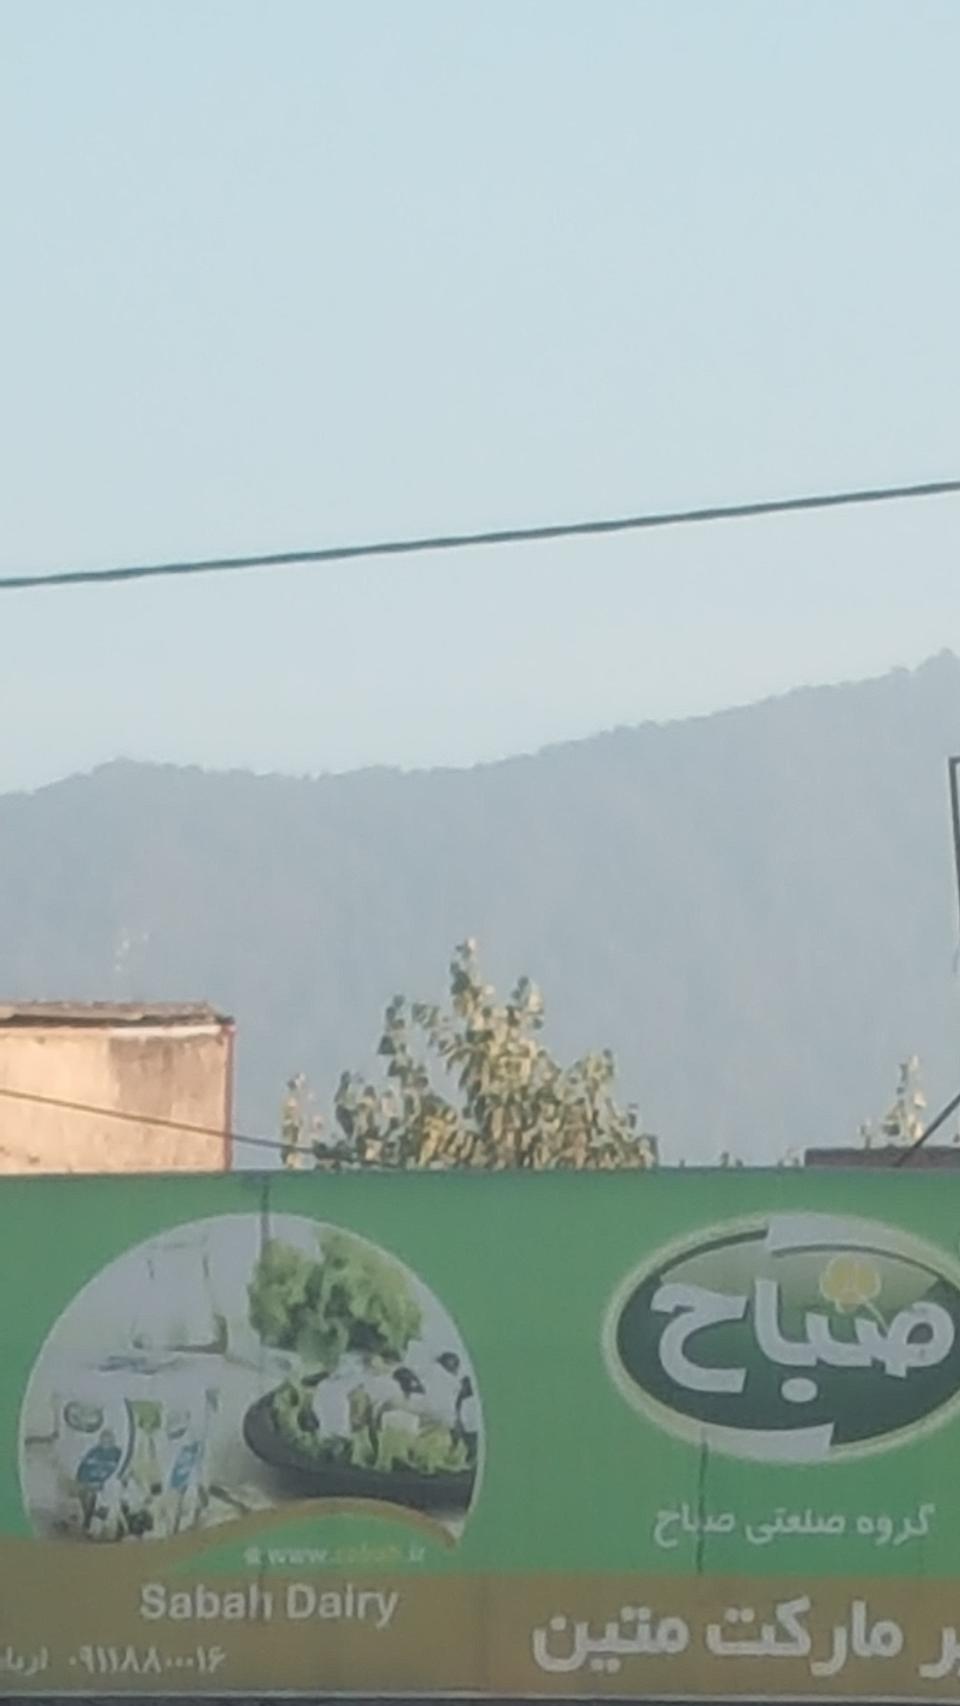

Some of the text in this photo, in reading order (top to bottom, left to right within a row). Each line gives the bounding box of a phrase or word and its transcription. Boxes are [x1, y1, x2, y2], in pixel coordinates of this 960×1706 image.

[650, 1277, 955, 1402] صباح
[654, 1503, 936, 1547] گروه صنعتی صباح
[140, 1583, 398, 1631] Sabah Dairy
[532, 1606, 689, 1673] متین
[706, 1596, 904, 1677] مارکت
